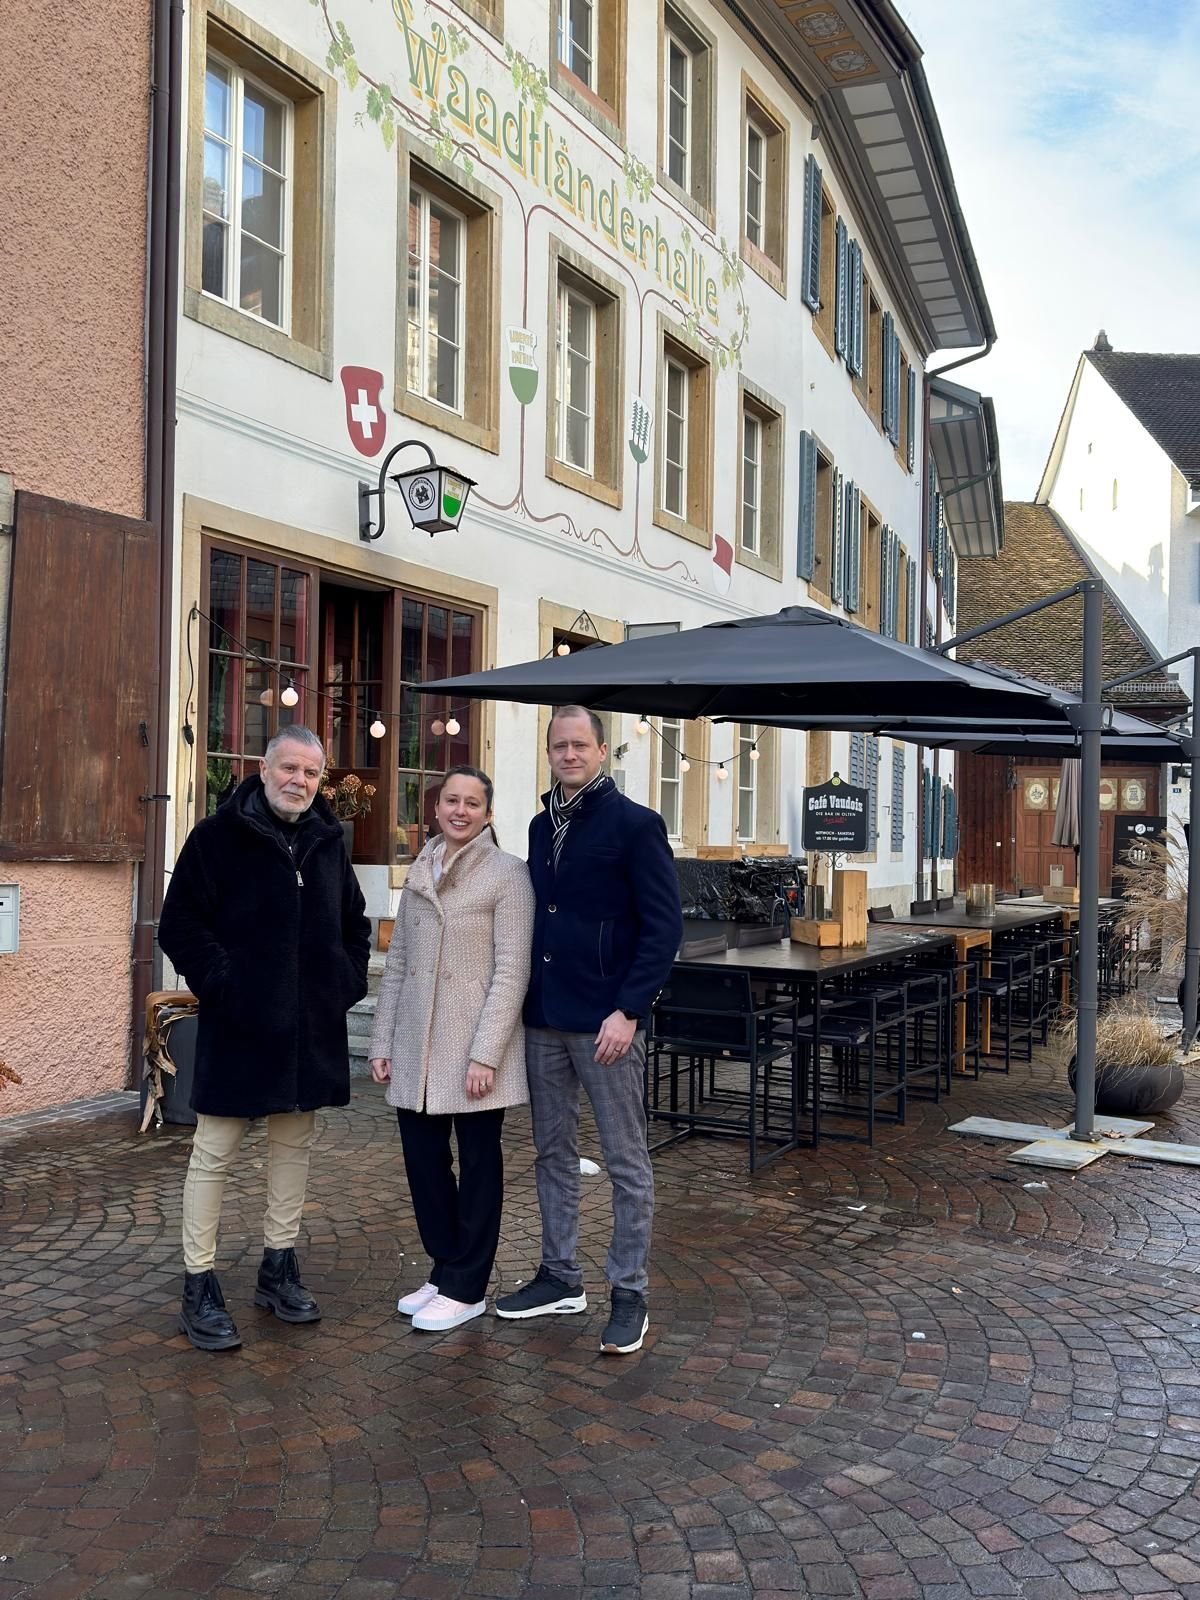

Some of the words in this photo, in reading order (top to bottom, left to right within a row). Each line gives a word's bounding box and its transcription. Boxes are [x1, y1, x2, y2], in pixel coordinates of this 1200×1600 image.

[391, 0, 719, 326] Waadtländerhalle
[579, 617, 589, 632] 23
[808, 794, 828, 810] Café
[830, 795, 863, 812] Vaudois
